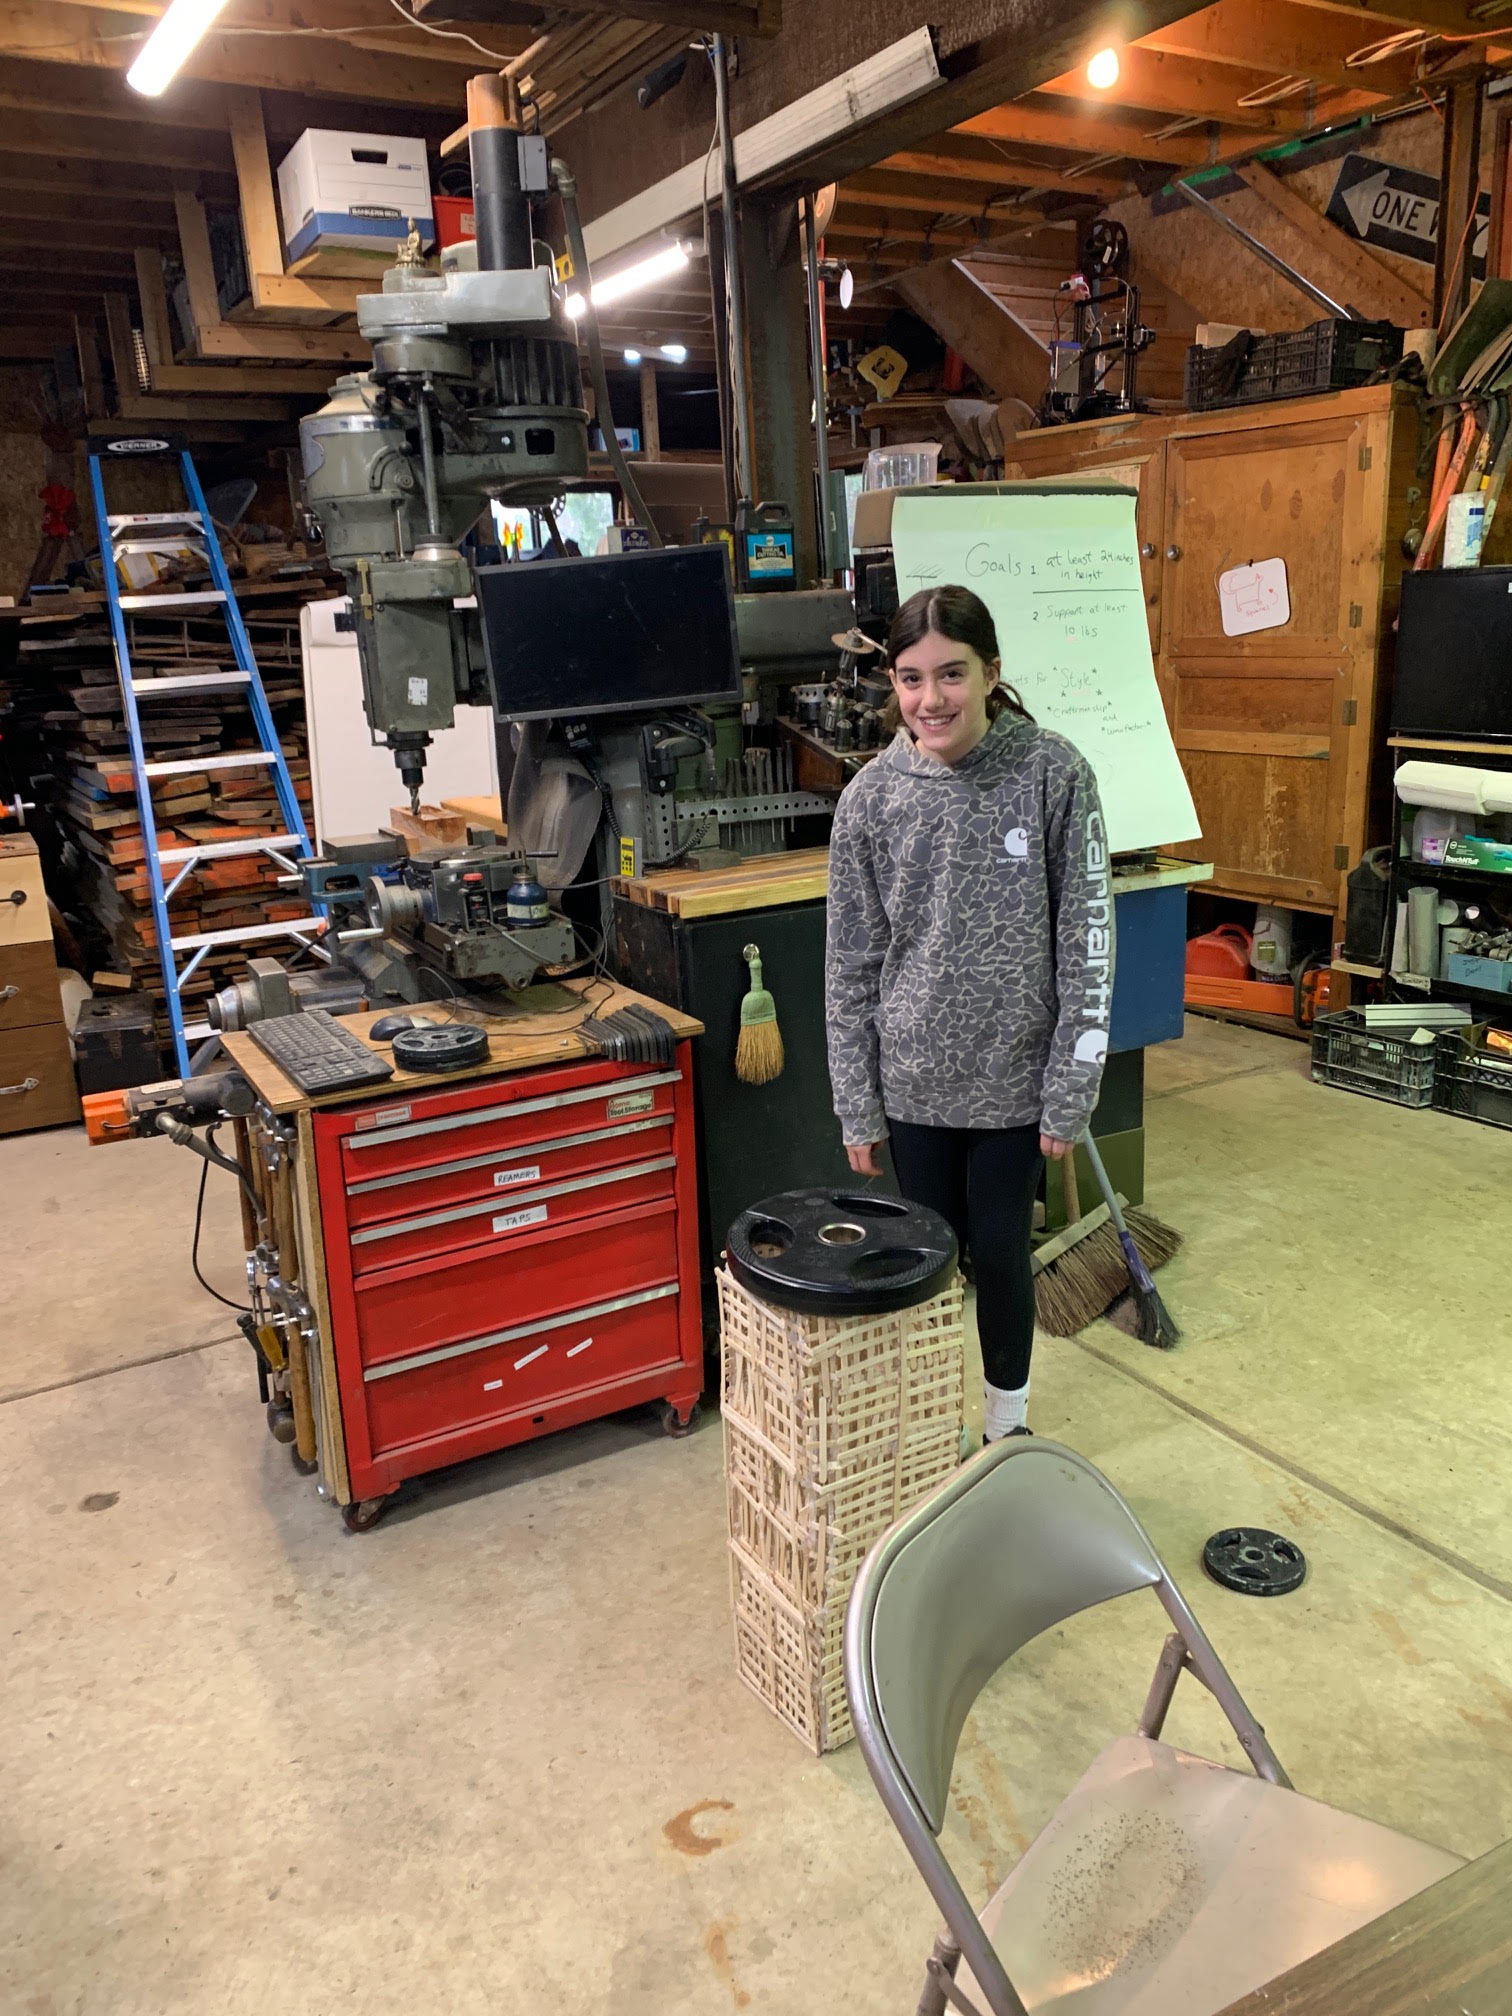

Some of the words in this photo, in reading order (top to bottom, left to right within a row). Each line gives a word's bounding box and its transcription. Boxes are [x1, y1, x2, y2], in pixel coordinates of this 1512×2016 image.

[1372, 190, 1426, 232] ONE
[120, 441, 157, 450] WERNER
[965, 542, 1022, 578] Goals
[1046, 552, 1062, 567] at
[1067, 548, 1092, 566] least
[1060, 570, 1071, 580] in
[1076, 568, 1104, 584] height
[1047, 605, 1083, 620] Support
[1089, 605, 1100, 614] at
[1105, 602, 1127, 614] least
[1064, 625, 1076, 636] 10
[1081, 625, 1099, 638] lbs
[1059, 667, 1093, 689] Style
[1082, 810, 1112, 1025] carhartt
[497, 1169, 537, 1184] REAMERS
[505, 1212, 532, 1226] TAPS
